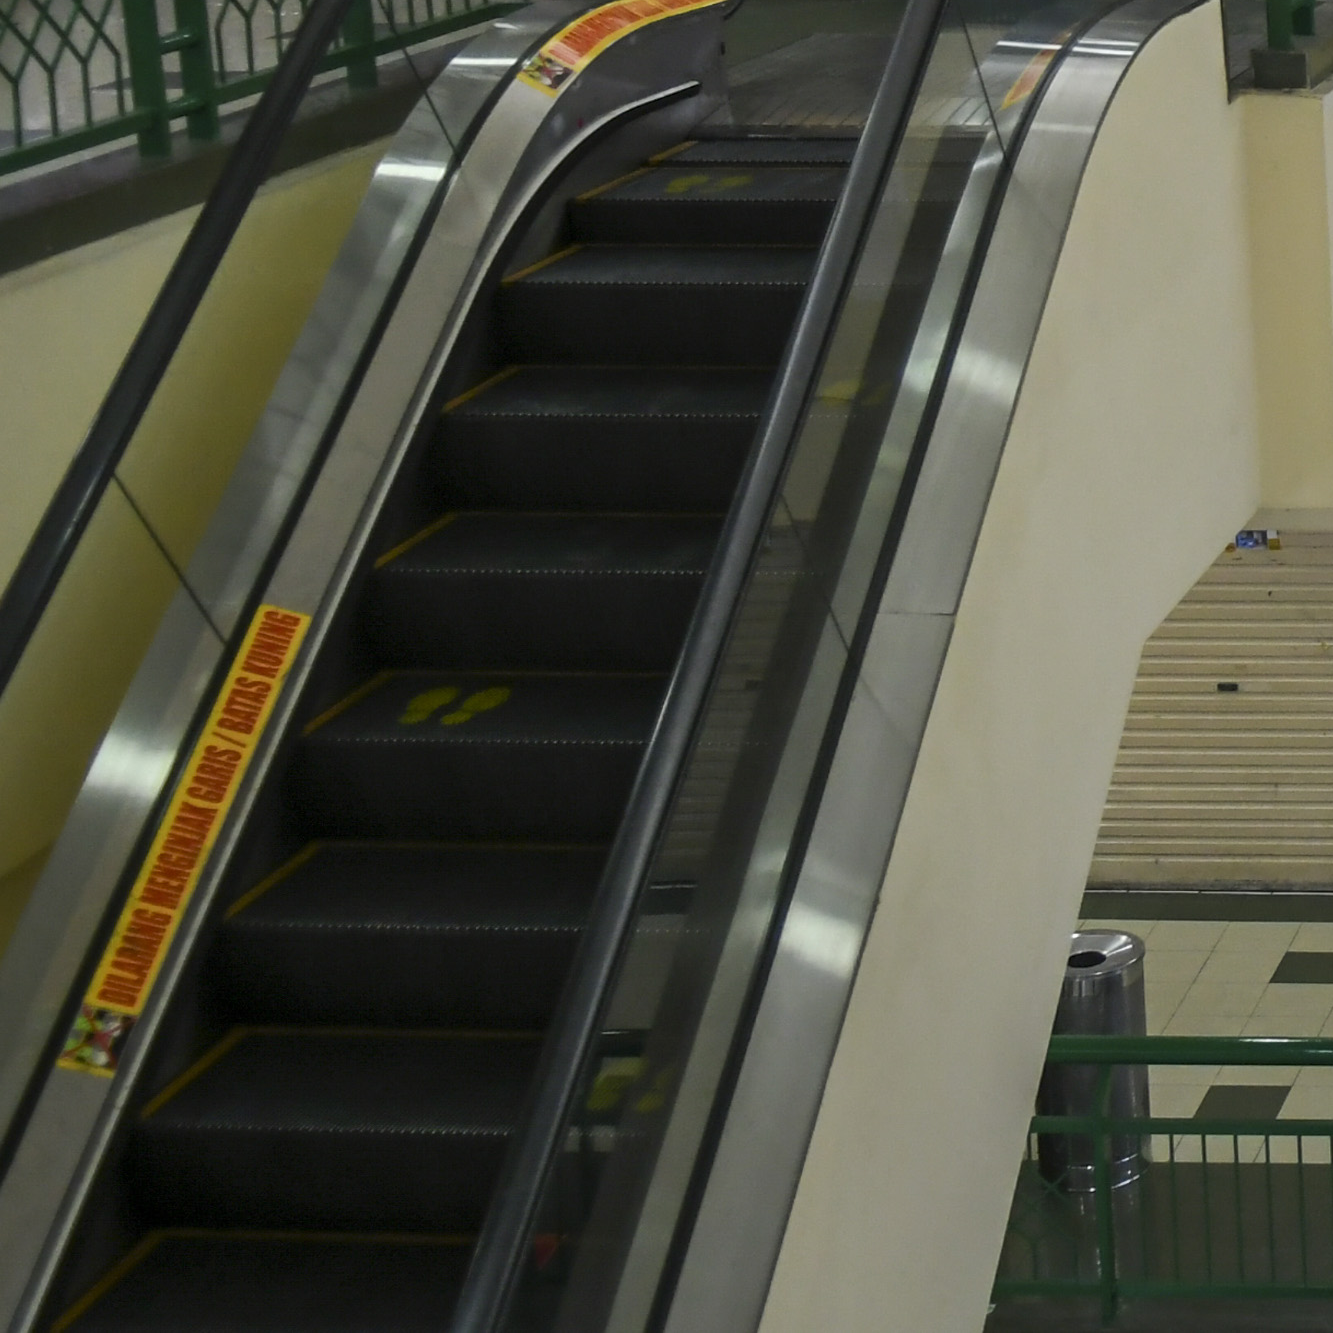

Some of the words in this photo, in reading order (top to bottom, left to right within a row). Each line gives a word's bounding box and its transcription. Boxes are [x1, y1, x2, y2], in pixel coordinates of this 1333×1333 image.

[241, 609, 303, 679] KUNING
[216, 676, 274, 736] BATAS
[186, 743, 244, 804] GARIS
[140, 801, 219, 911] MENGINJAK
[98, 907, 175, 1009] DILARANG
